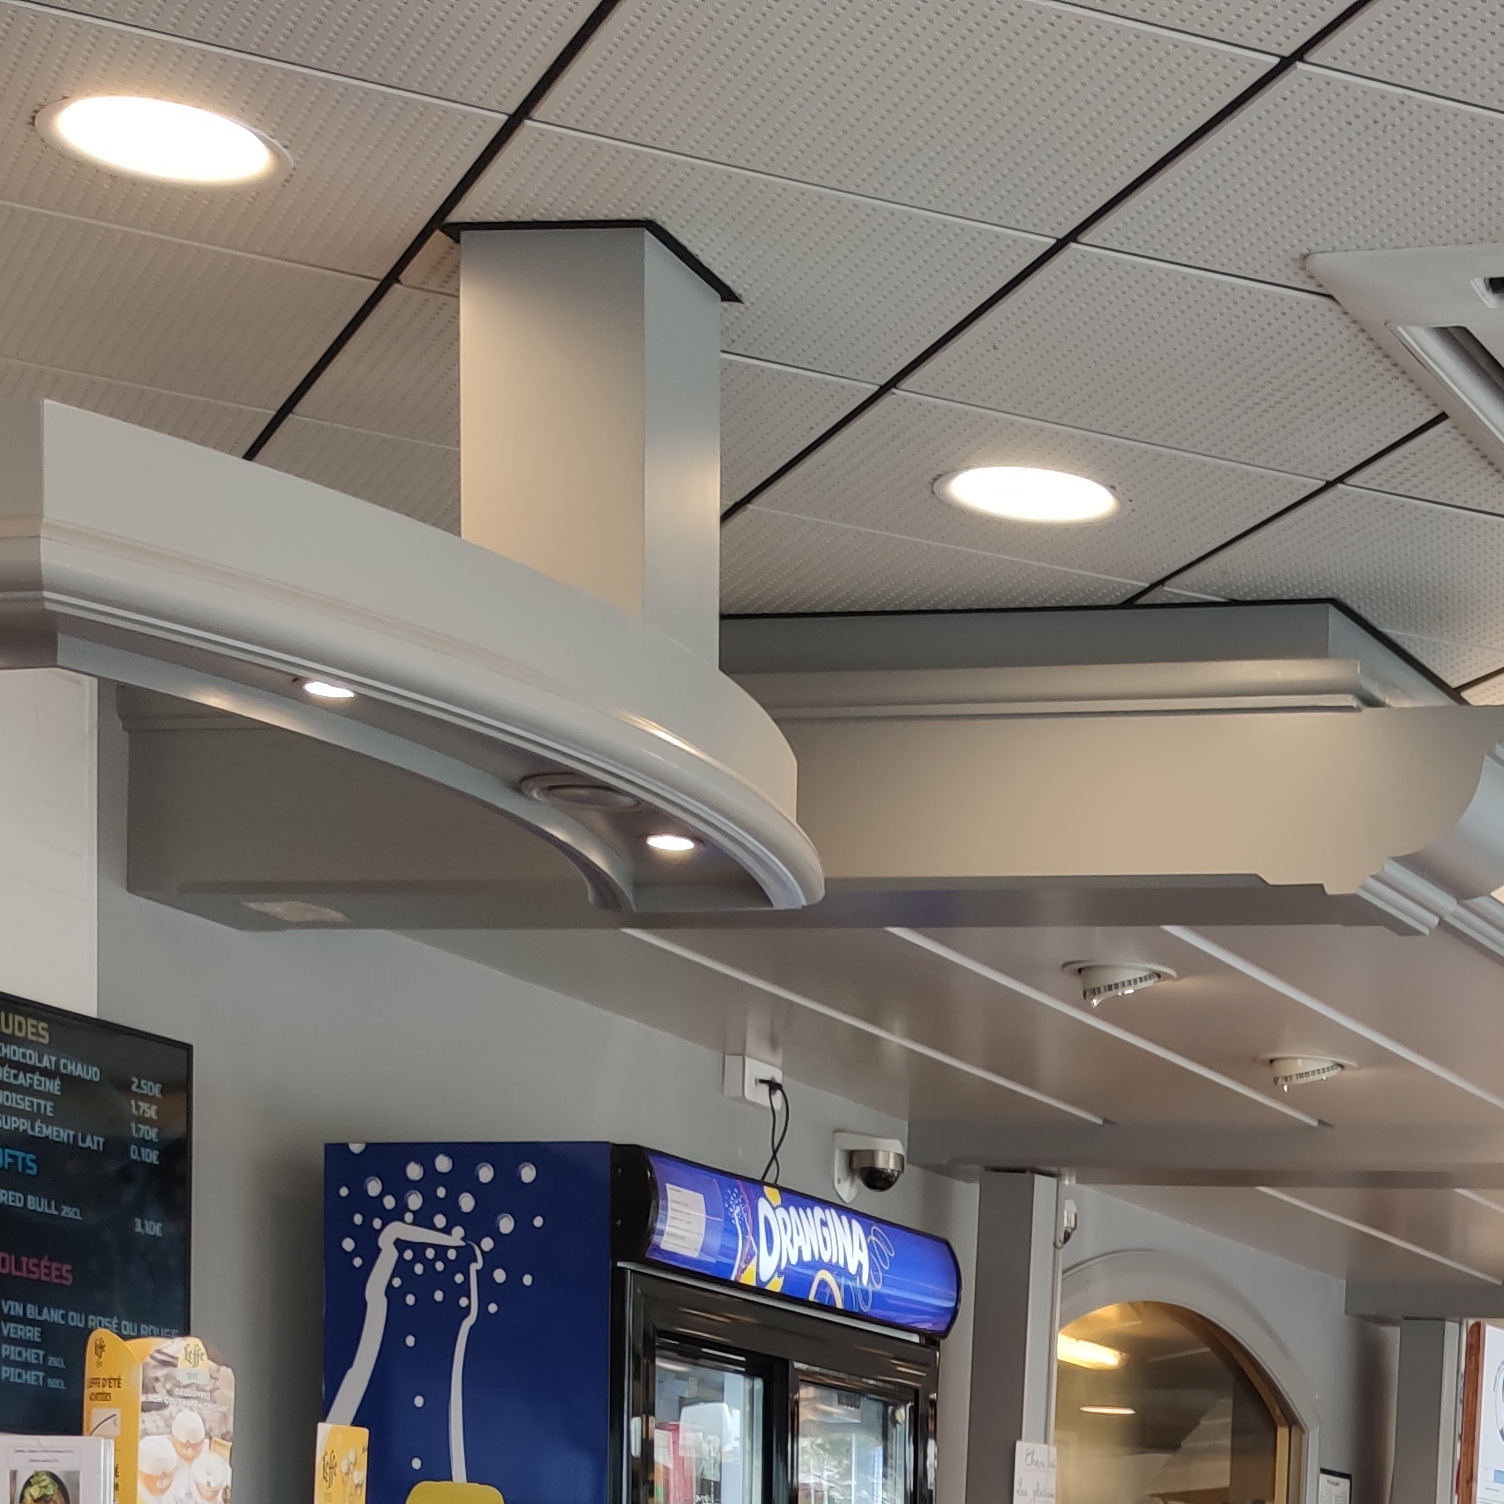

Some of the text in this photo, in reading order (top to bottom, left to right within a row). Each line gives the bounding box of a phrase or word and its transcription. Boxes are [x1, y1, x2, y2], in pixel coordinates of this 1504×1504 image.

[60, 1057, 100, 1082] CHAUD
[78, 1131, 105, 1152] LAIT
[0, 1189, 24, 1208] RED
[27, 1194, 58, 1215] BULL
[1, 1299, 23, 1317] VIN
[26, 1307, 66, 1326] BLANC
[68, 1311, 85, 1327] OU
[122, 1322, 137, 1336] OU
[1, 1321, 41, 1342] VERRE
[1, 1344, 45, 1365] PICHET
[1, 1366, 45, 1387] PICHET
